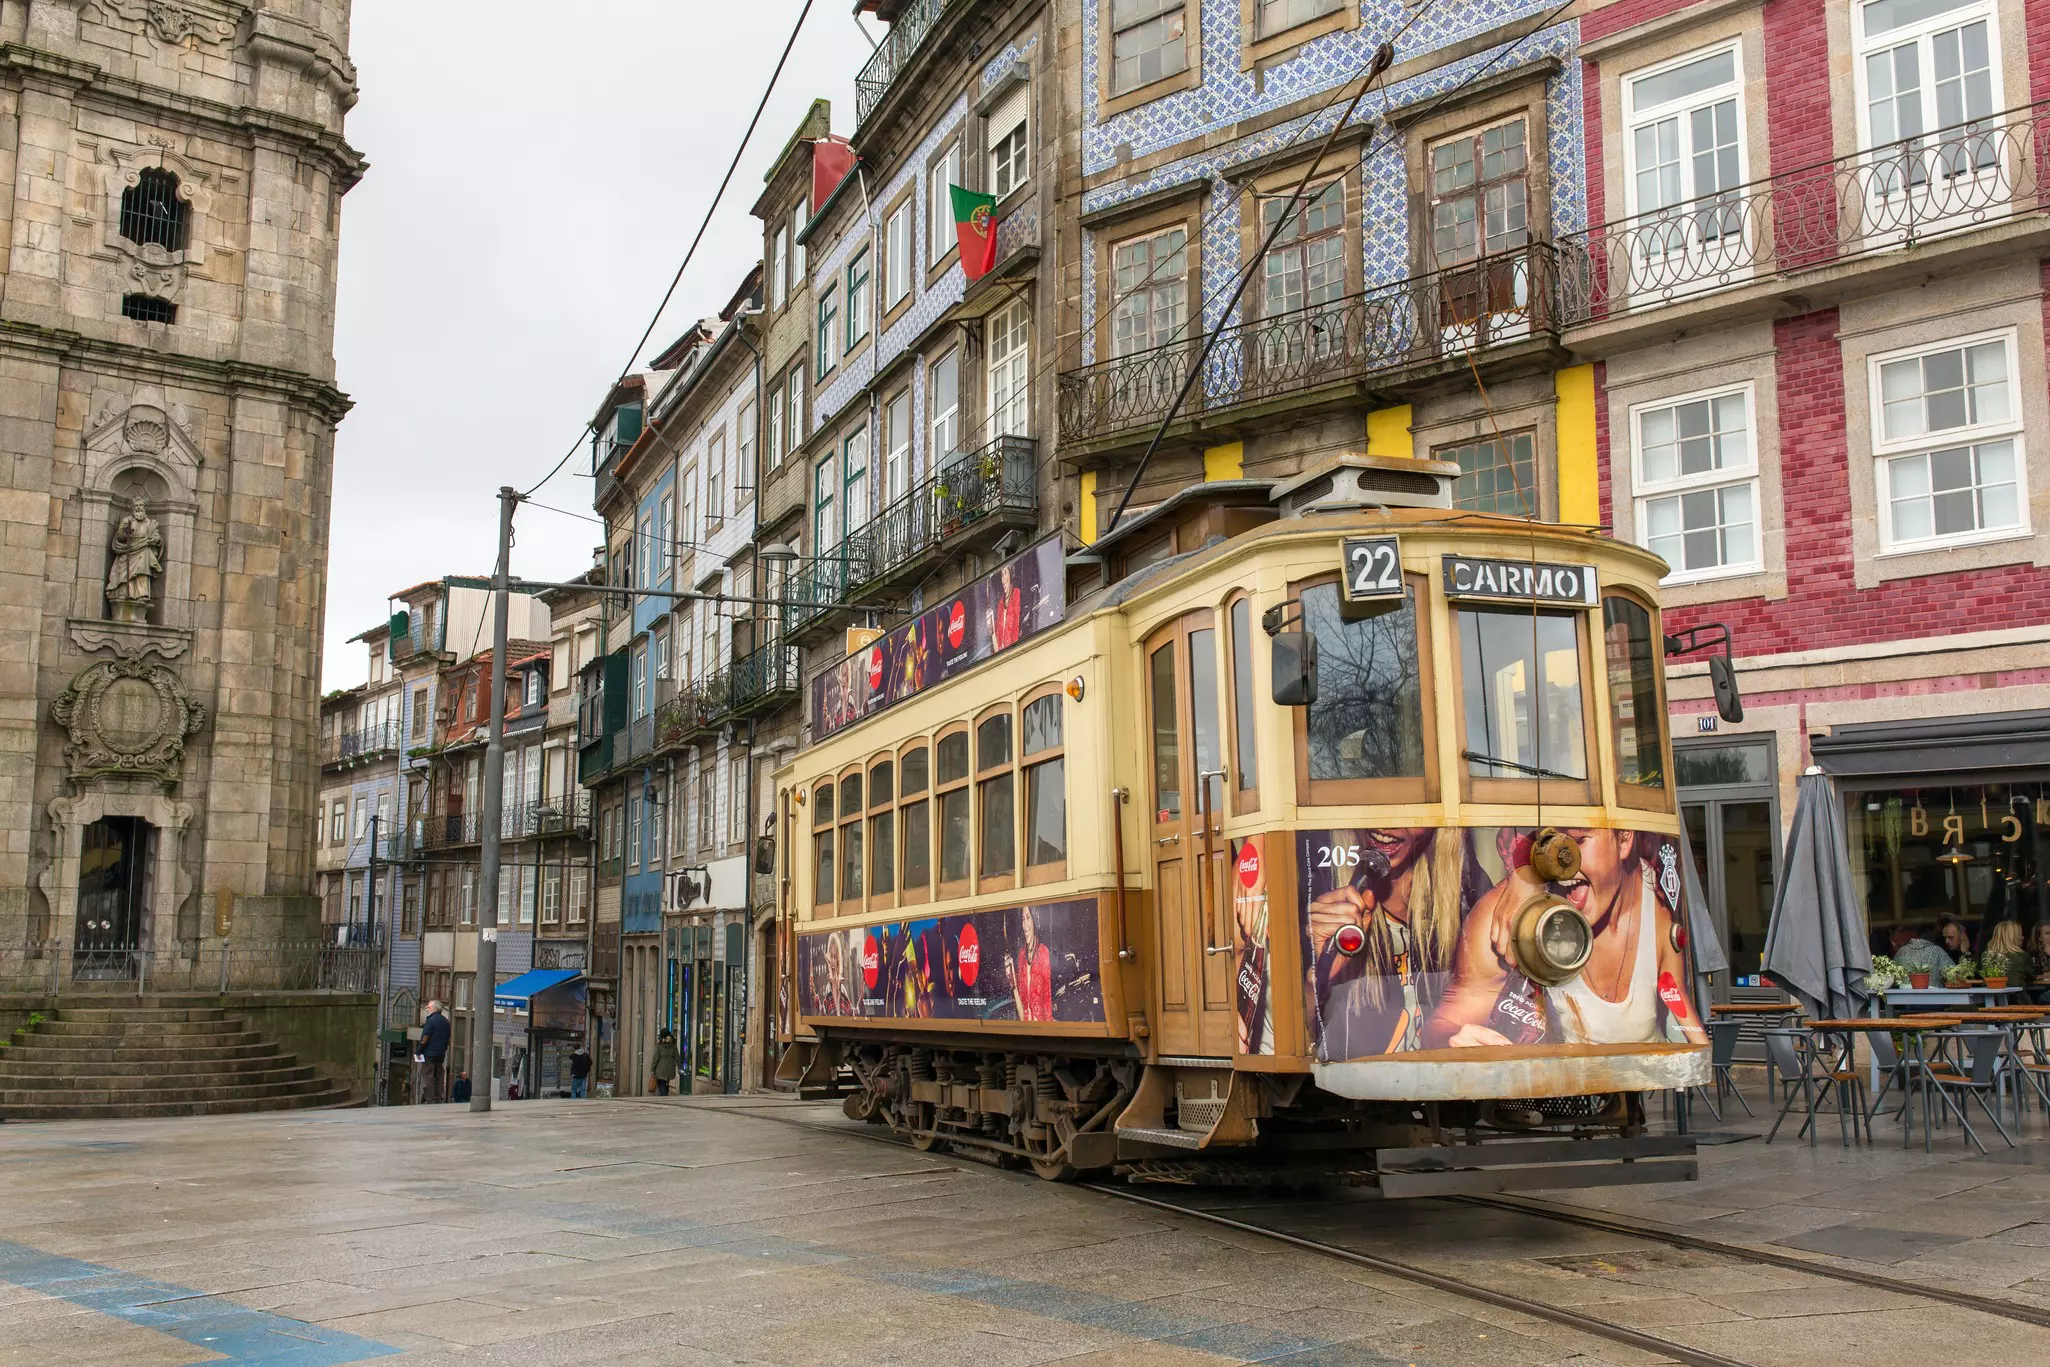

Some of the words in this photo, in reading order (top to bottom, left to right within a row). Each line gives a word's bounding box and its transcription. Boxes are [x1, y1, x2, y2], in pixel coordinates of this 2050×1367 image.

[1351, 545, 1400, 590] 22
[1450, 562, 1579, 598] CARMO
[1700, 718, 1714, 730] 101
[1239, 857, 1258, 873] Coca-Cola
[1317, 845, 1361, 868] 205
